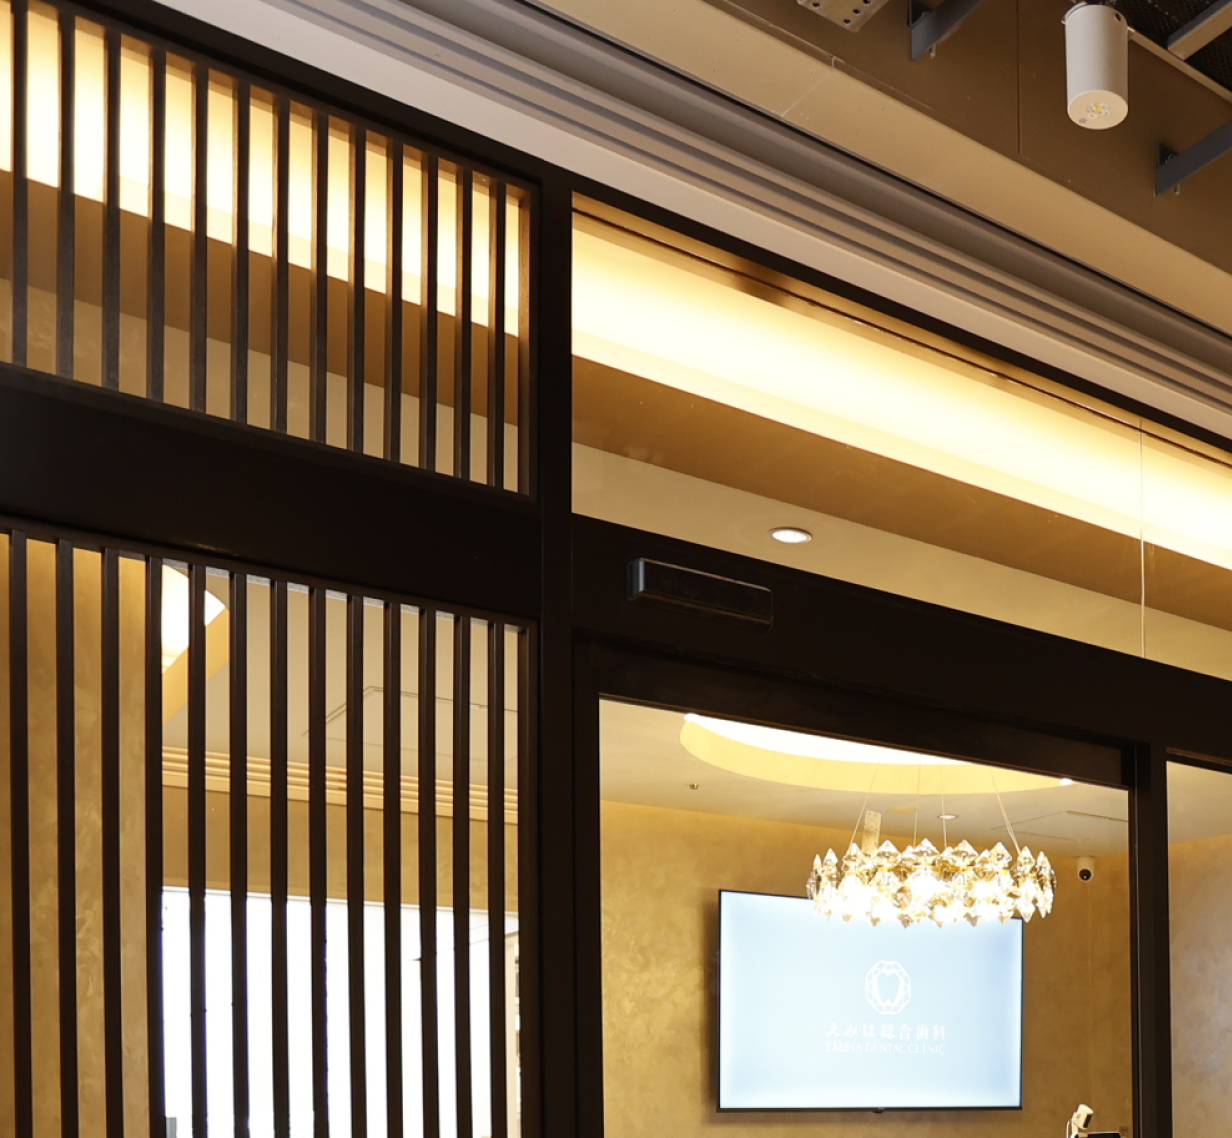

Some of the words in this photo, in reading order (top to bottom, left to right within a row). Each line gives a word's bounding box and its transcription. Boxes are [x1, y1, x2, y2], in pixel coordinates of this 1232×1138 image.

[826, 1022, 946, 1041] えみは総合歯科
[827, 1041, 862, 1053] EMIHA
[865, 1042, 905, 1054] DENTAL
[908, 1043, 946, 1054] CLINIC
